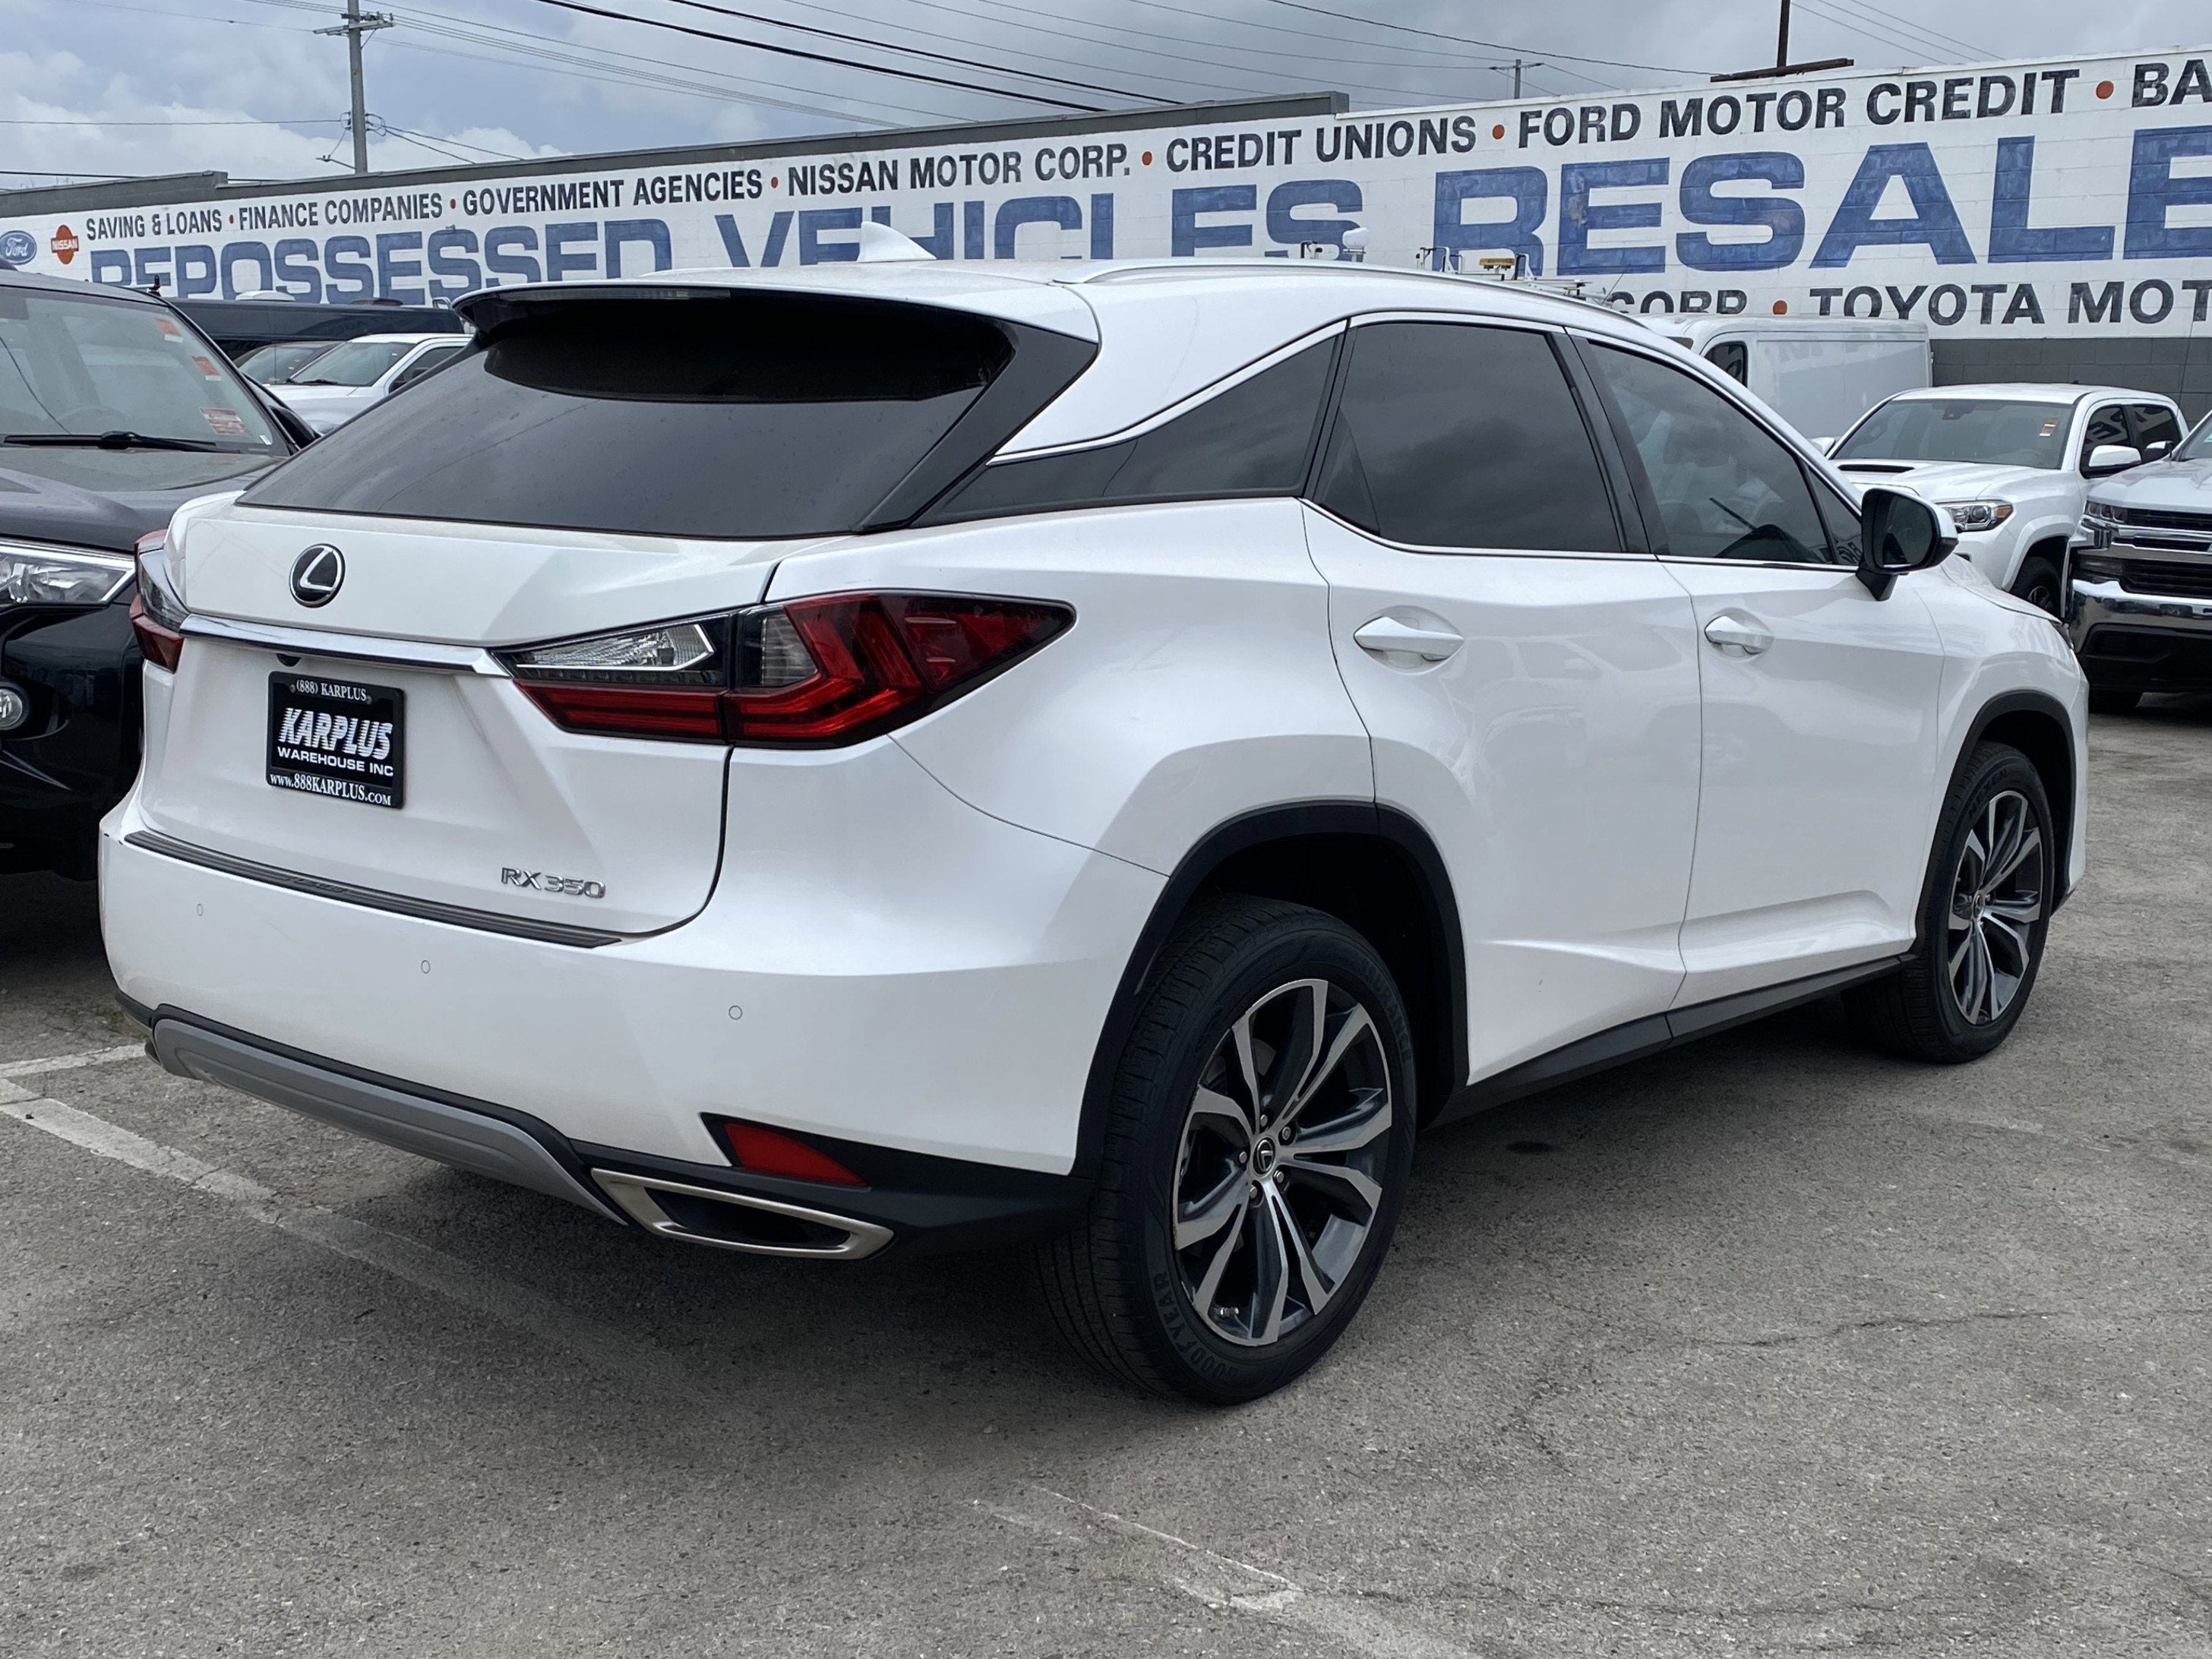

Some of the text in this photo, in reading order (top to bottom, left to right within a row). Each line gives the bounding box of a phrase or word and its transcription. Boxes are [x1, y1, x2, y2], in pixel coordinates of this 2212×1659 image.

[87, 215, 145, 241] SAVING
[152, 213, 161, 235] &
[166, 209, 223, 235] LOANS
[239, 202, 318, 230] FINANCE
[325, 193, 443, 225] COMPANIES
[463, 179, 624, 216] GOVERNMENT
[633, 169, 763, 206] AGENCIES
[788, 160, 899, 197] NISSAN
[910, 151, 1022, 189] MOTOR
[1035, 143, 1130, 181] CORP.
[1167, 129, 1302, 172] CREDIT
[1316, 115, 1476, 163] UNIONS
[1518, 103, 1641, 149] FORD
[1659, 87, 1847, 138] MOTOR
[1866, 68, 2080, 125] CREDIT
[1433, 125, 2212, 276] RESALE
[5, 237, 28, 257] Ford
[1809, 283, 2045, 326] TOYOTA
[2068, 279, 2212, 324] MOT
[296, 679, 367, 702] (888) KARPLUS
[277, 707, 393, 760] KARPLUS
[277, 746, 393, 776] WAREHOUSE INC
